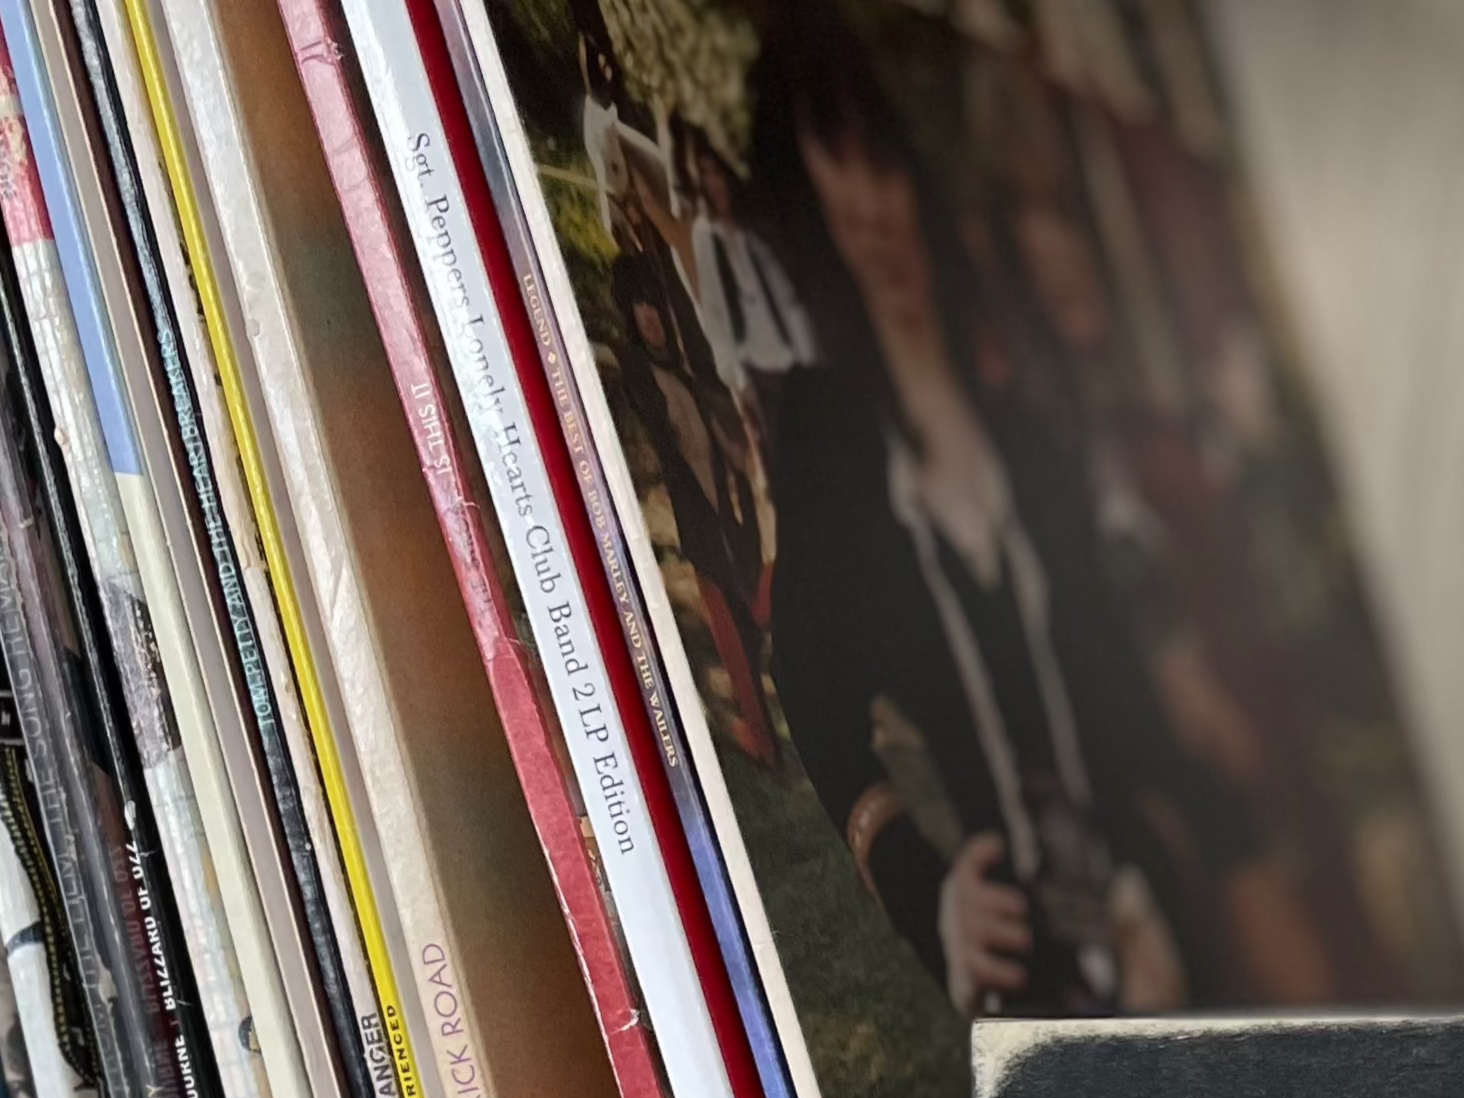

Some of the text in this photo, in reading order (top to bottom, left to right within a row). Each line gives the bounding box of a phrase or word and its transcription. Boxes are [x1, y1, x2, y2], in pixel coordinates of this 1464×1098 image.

[411, 380, 453, 474] IS THIS IT
[406, 133, 432, 186] Sgt.
[425, 195, 470, 308] Peppers
[462, 315, 506, 410] Lonely
[498, 421, 534, 516] Hearts
[525, 525, 561, 594] Club
[548, 601, 589, 676] Band
[593, 752, 636, 855] Edition
[523, 274, 678, 767] LEGEND THE BEST OF BOB MARLEY AND THE WAILERS
[219, 563, 237, 608] AND
[233, 616, 259, 674] PETTY
[16, 670, 47, 757] SONG
[250, 683, 275, 728] TOM
[422, 943, 464, 1038] ROAD
